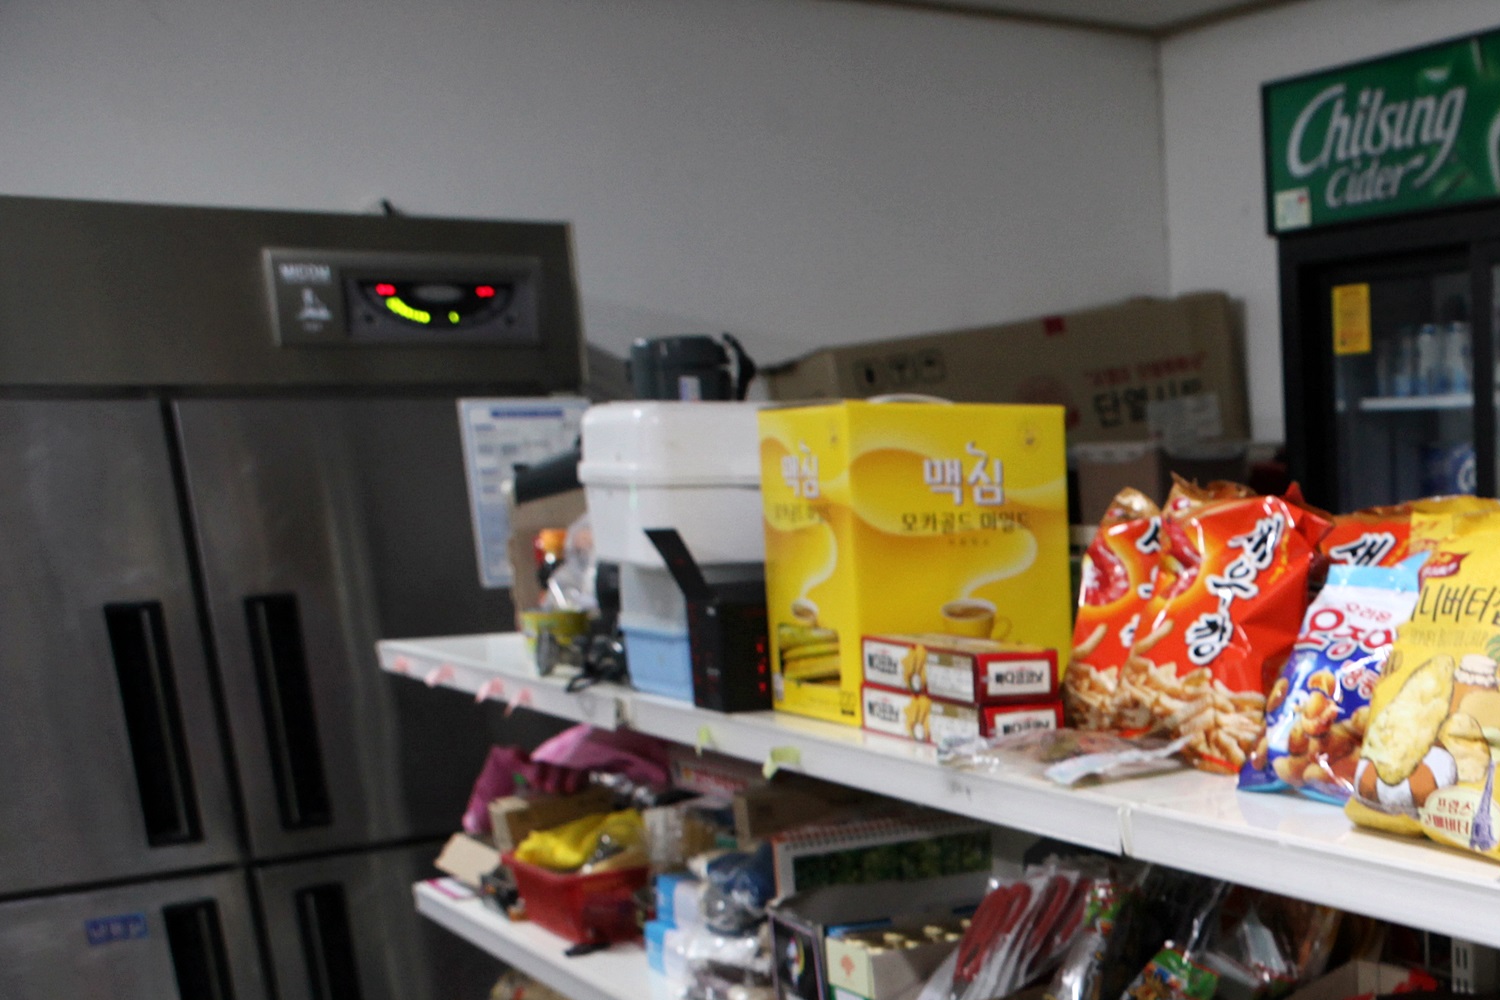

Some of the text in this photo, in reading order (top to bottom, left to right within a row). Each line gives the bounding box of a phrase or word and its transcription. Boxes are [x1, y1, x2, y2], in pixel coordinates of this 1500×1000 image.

[1287, 84, 1467, 188] Chilsung
[1326, 152, 1425, 208] Cider
[924, 442, 1005, 506] 맥심
[1186, 511, 1284, 665] 새우깡
